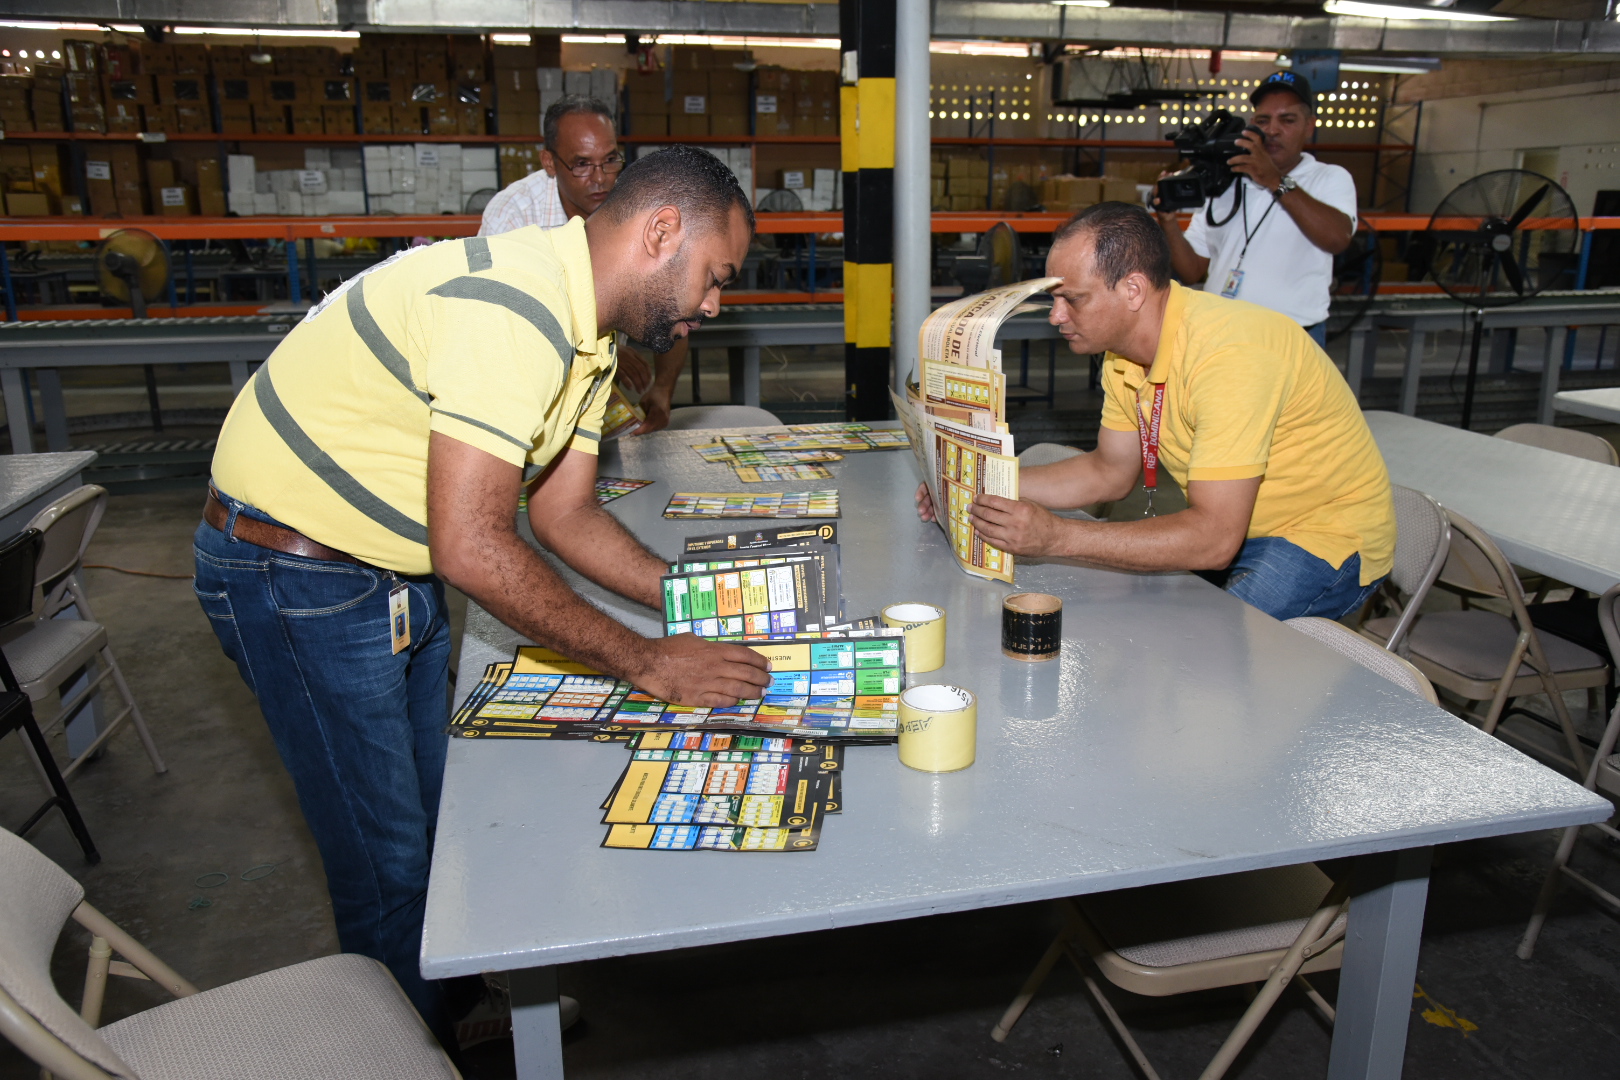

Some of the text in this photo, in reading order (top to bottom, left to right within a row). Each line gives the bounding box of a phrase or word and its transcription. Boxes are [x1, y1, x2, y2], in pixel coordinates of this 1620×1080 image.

[950, 339, 962, 358] DE
[1150, 389, 1163, 447] DOMINICANA
[822, 528, 830, 538] D
